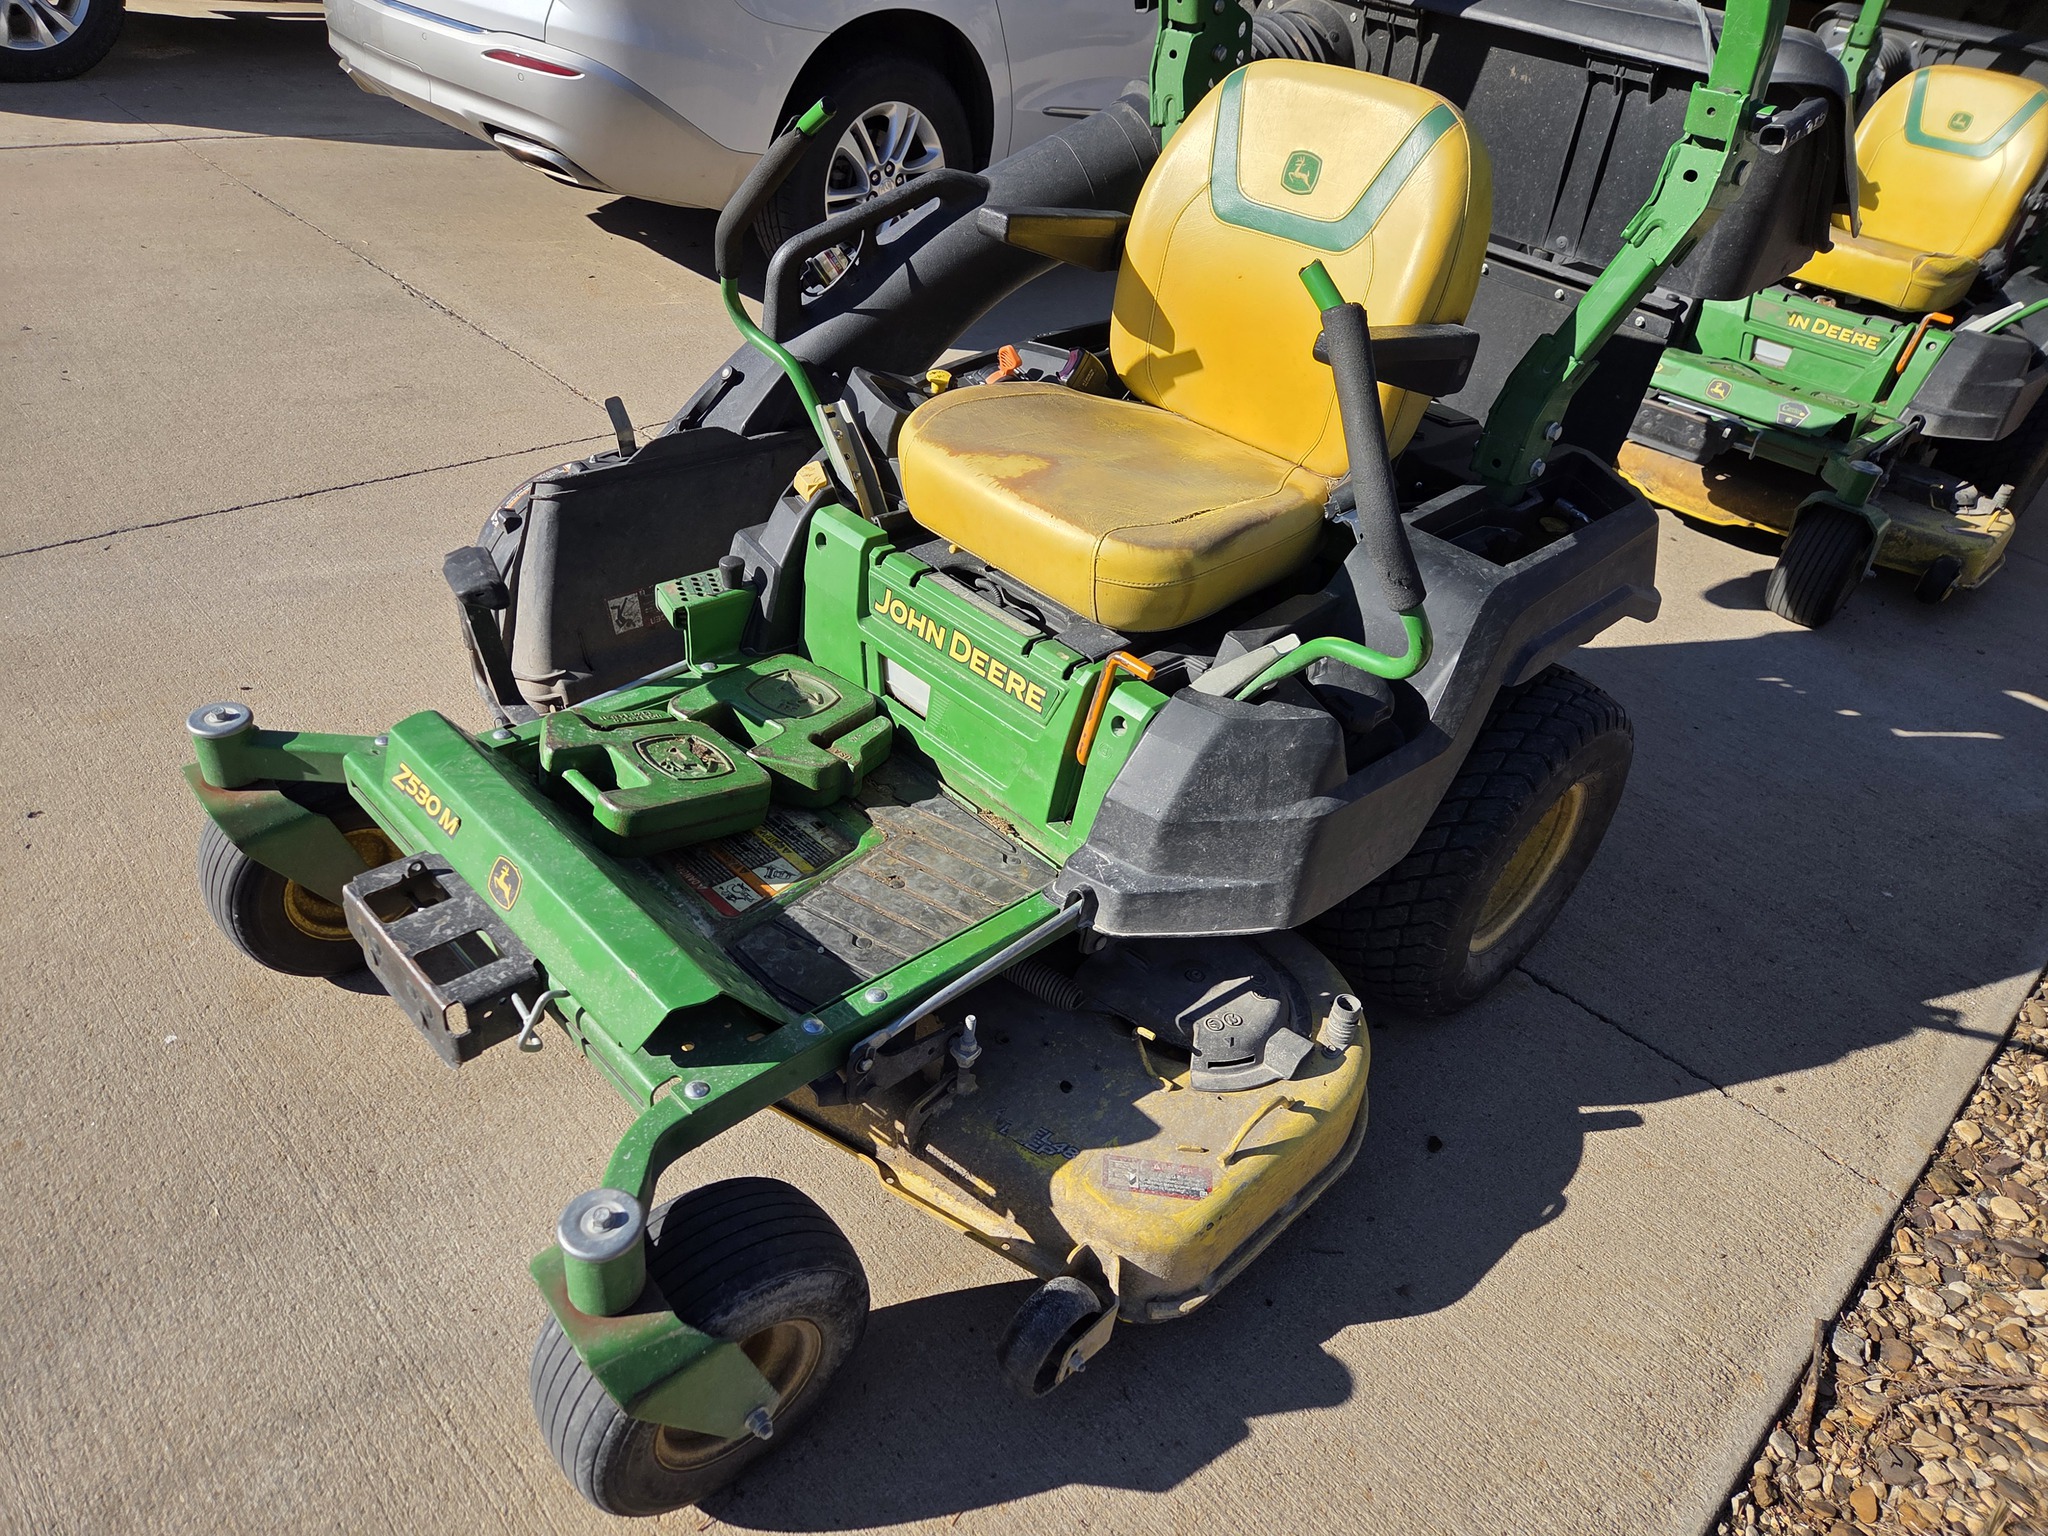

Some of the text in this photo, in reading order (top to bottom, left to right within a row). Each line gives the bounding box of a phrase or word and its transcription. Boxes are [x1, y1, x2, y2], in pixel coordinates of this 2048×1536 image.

[1811, 317, 1881, 351] DEERE
[874, 587, 1047, 714] JOHN DEERE
